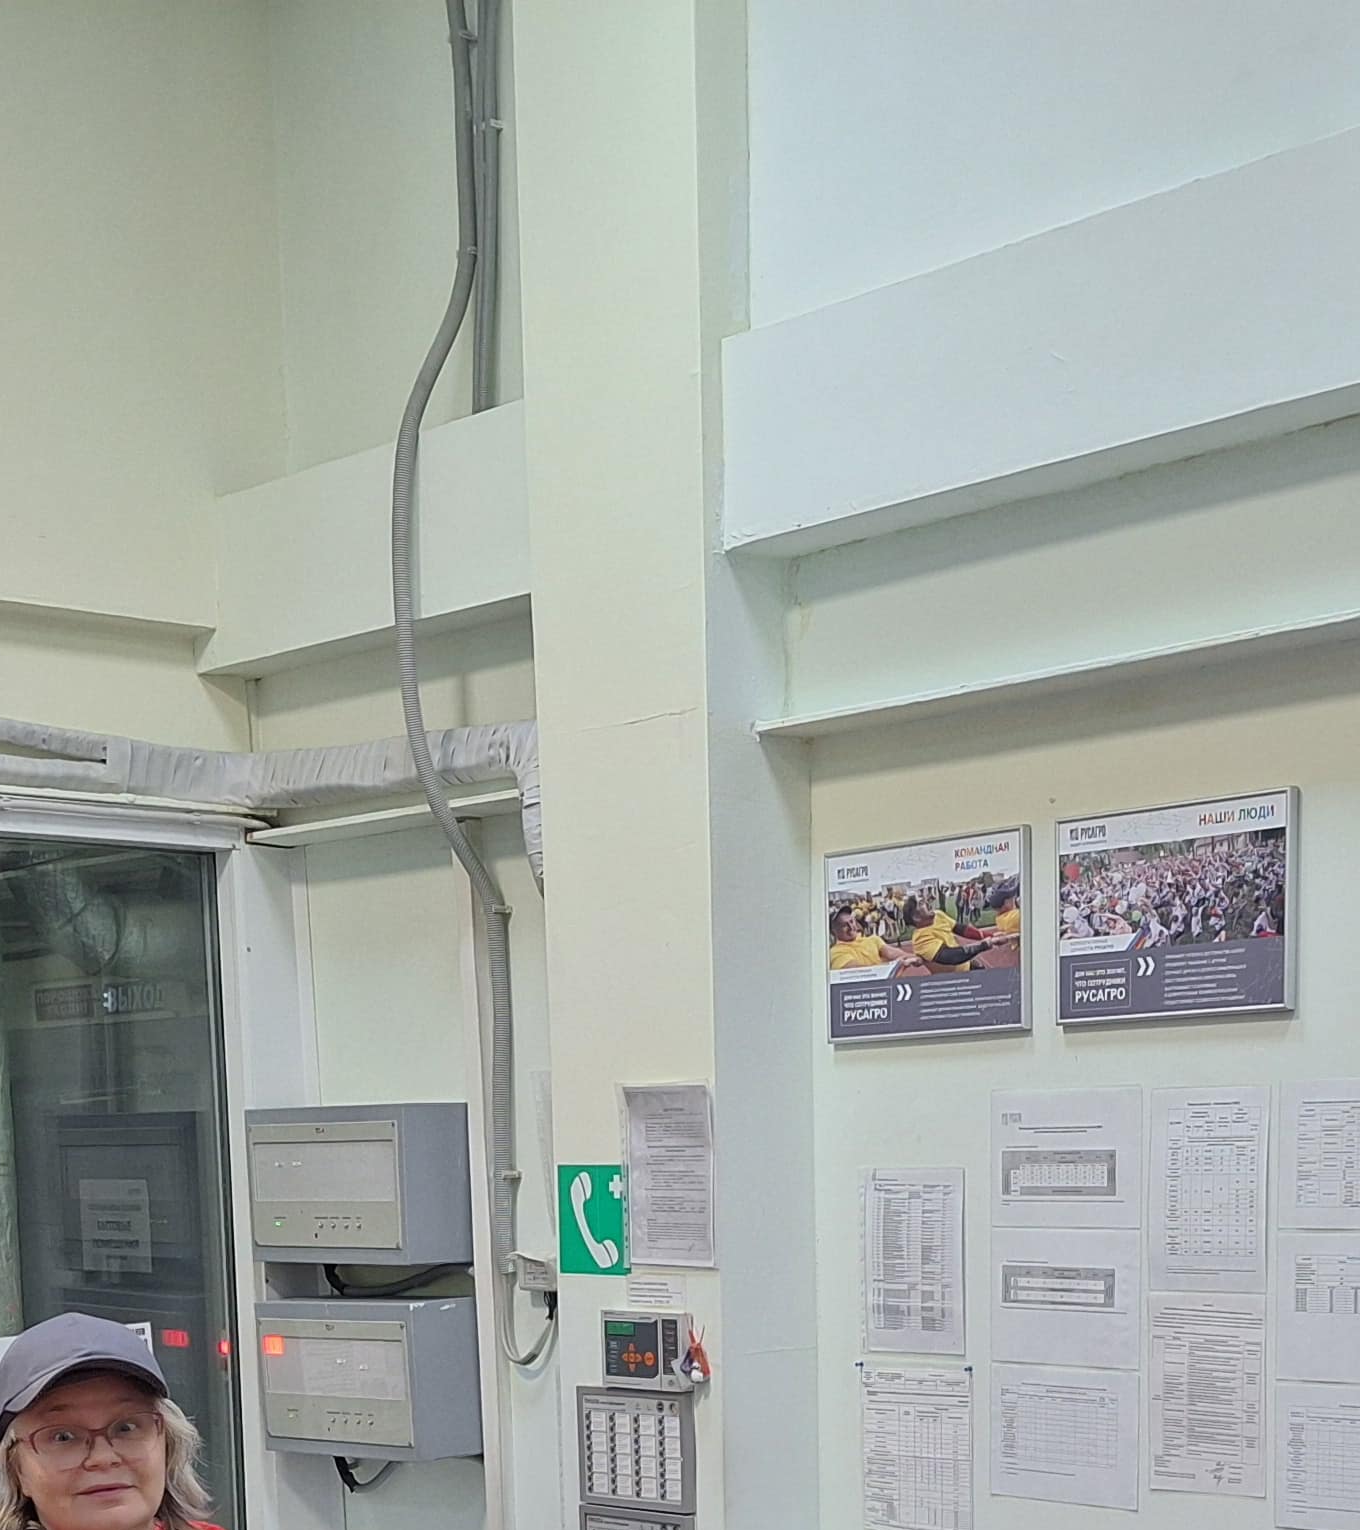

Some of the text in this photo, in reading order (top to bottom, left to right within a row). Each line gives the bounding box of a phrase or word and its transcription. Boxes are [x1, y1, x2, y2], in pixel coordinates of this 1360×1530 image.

[1199, 804, 1275, 826] НАШИ ЛЮДИ
[954, 842, 1010, 858] КОМАНДНАЯ
[955, 859, 988, 871] РАБОТА
[1075, 987, 1126, 1003] РУСАГРО
[844, 1008, 888, 1021] РУСАГРО
